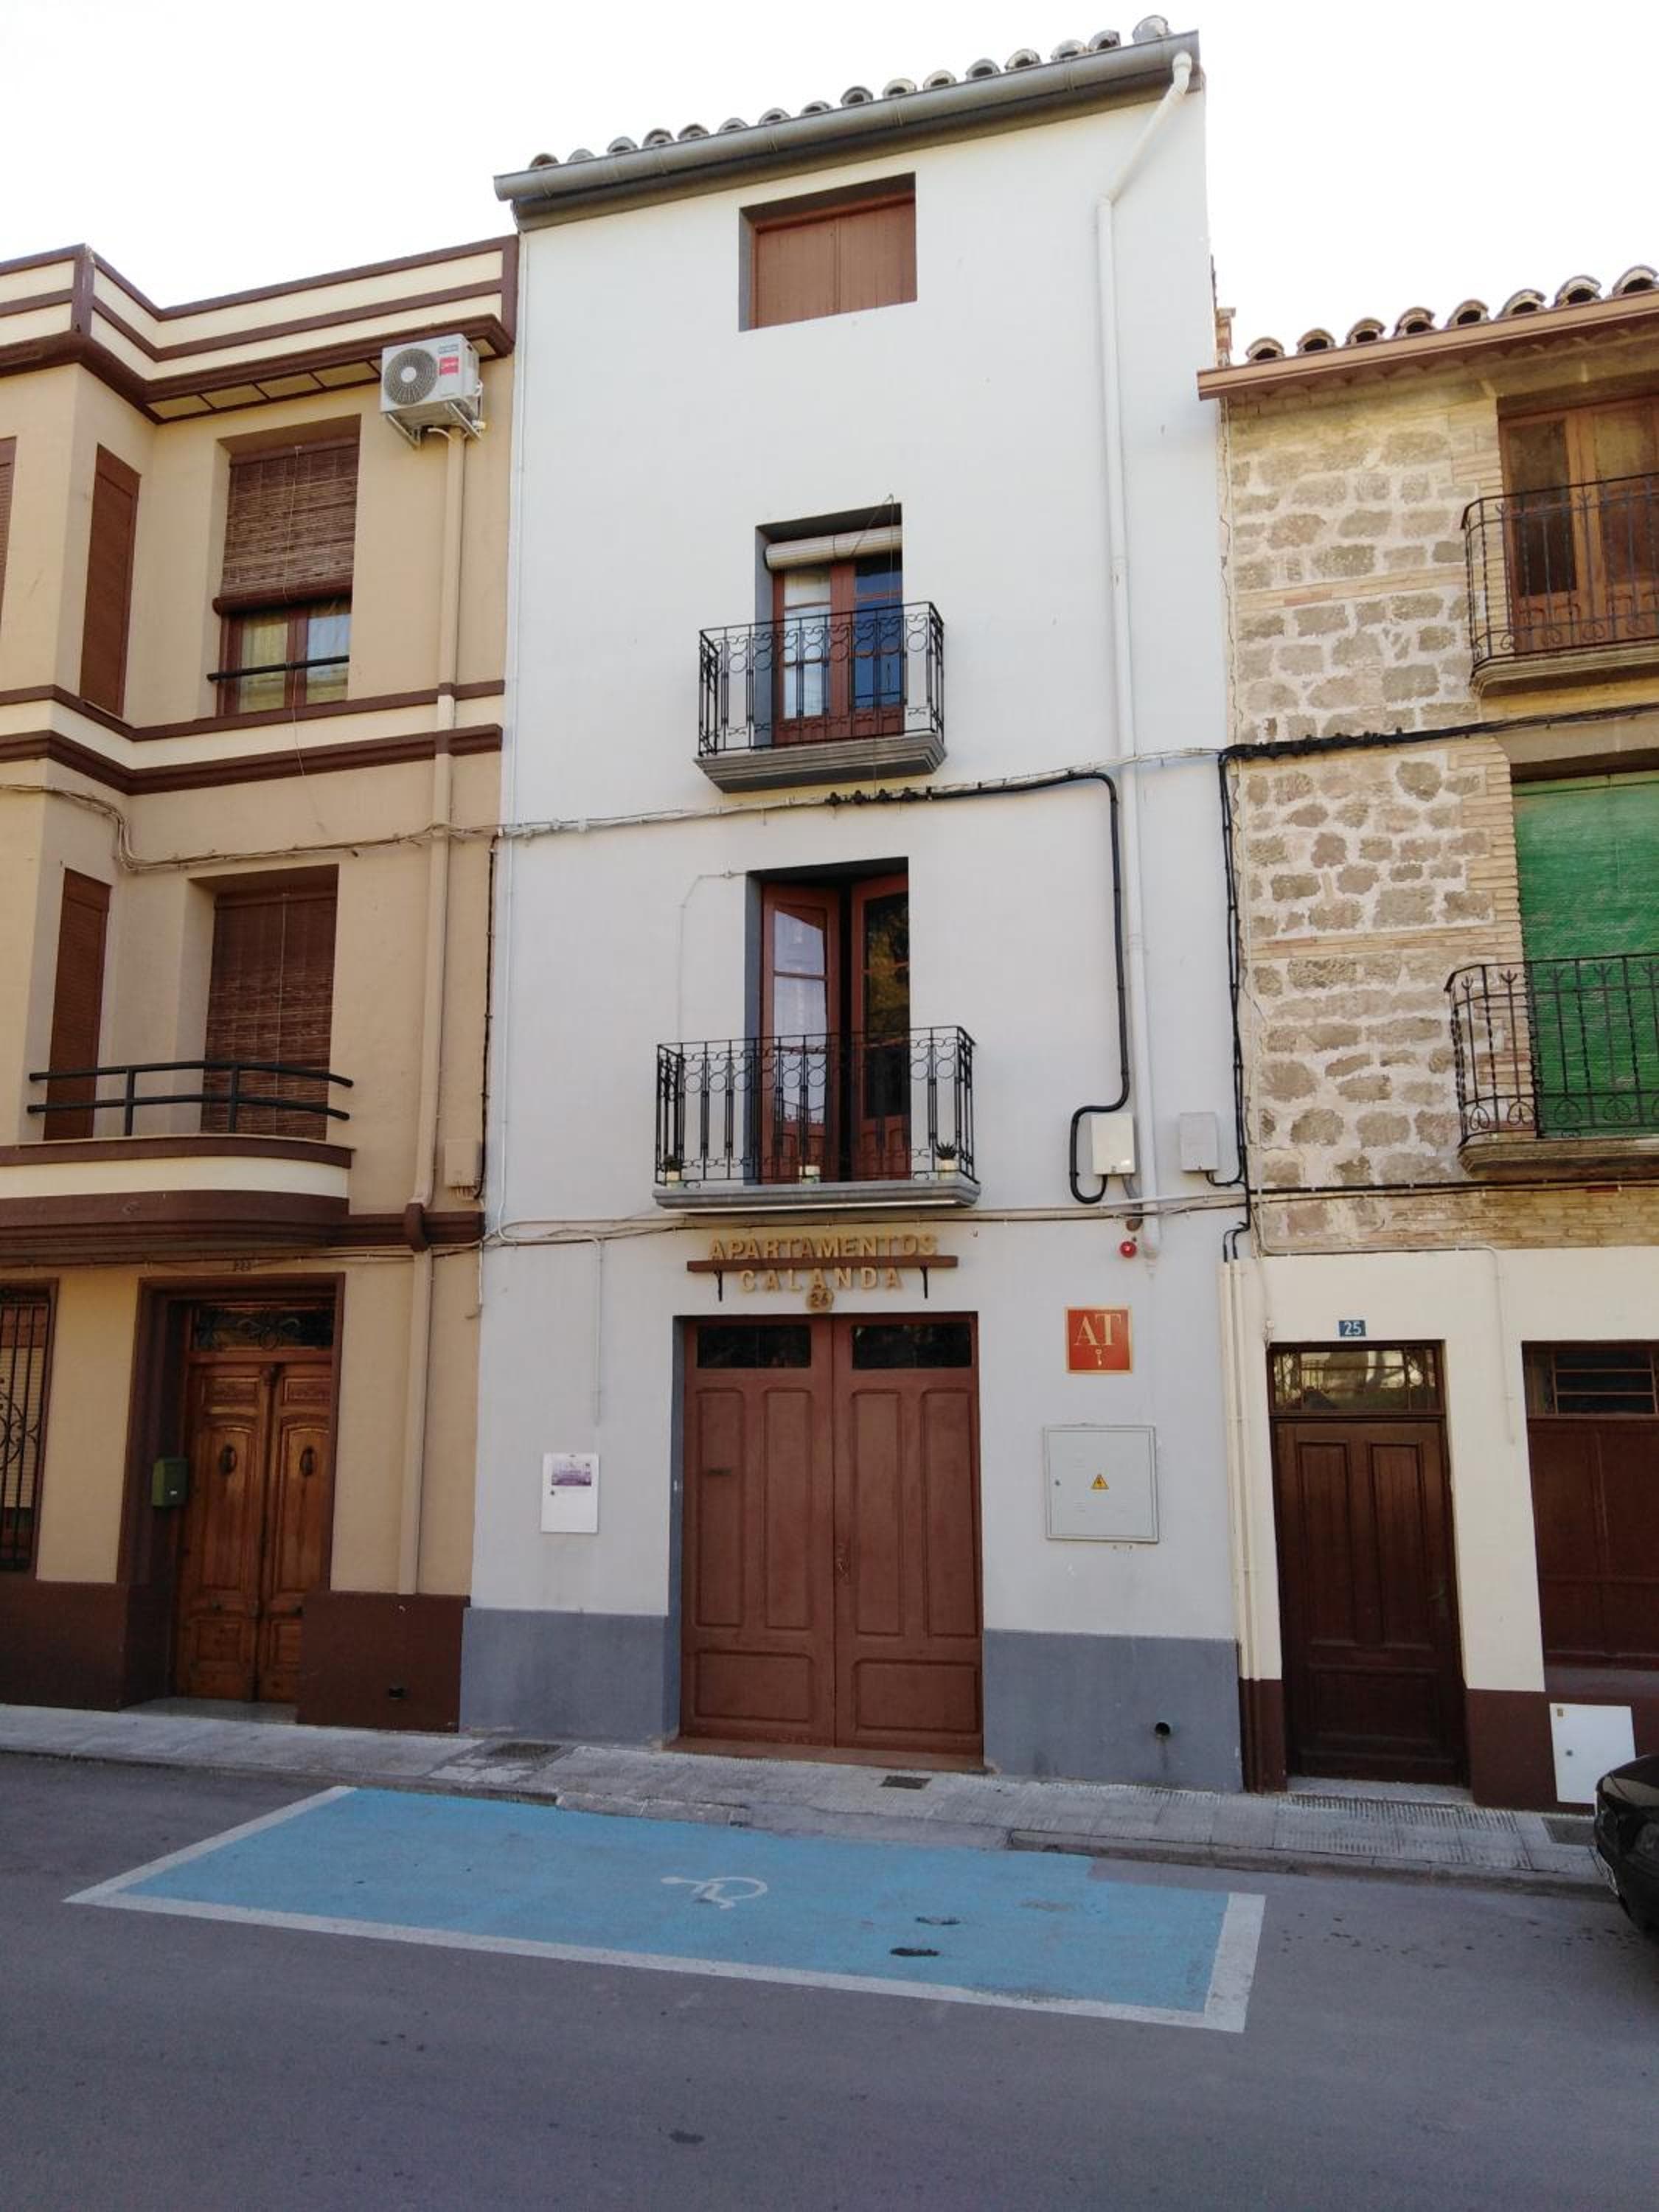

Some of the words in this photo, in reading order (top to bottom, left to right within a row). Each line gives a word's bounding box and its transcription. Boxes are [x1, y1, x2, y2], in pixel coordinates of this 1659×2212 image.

[709, 1234, 938, 1259] APARTAMENTOS
[741, 1266, 903, 1292] CALANDA
[1074, 1313, 1121, 1346] AT
[1344, 1321, 1362, 1335] 25
